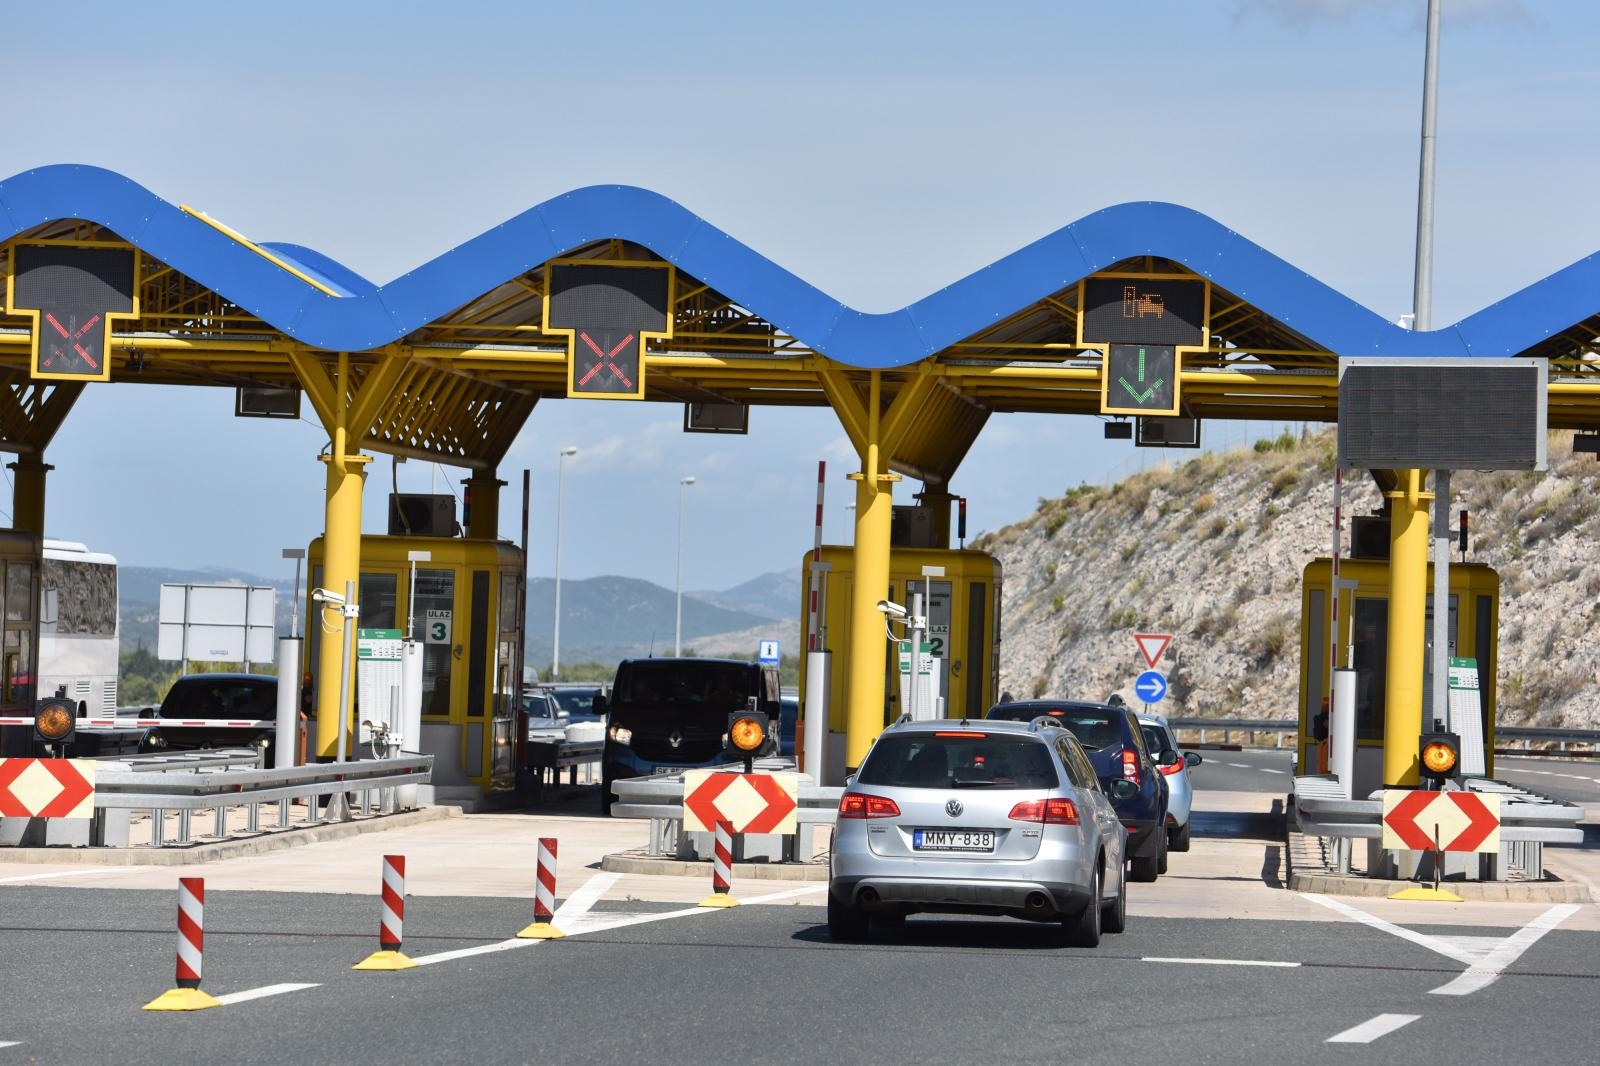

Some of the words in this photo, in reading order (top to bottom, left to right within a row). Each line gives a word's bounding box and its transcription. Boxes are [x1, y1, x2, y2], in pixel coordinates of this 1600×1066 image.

[431, 622, 447, 641] 3
[930, 637, 944, 656] 2
[925, 832, 990, 846] MMY-838
